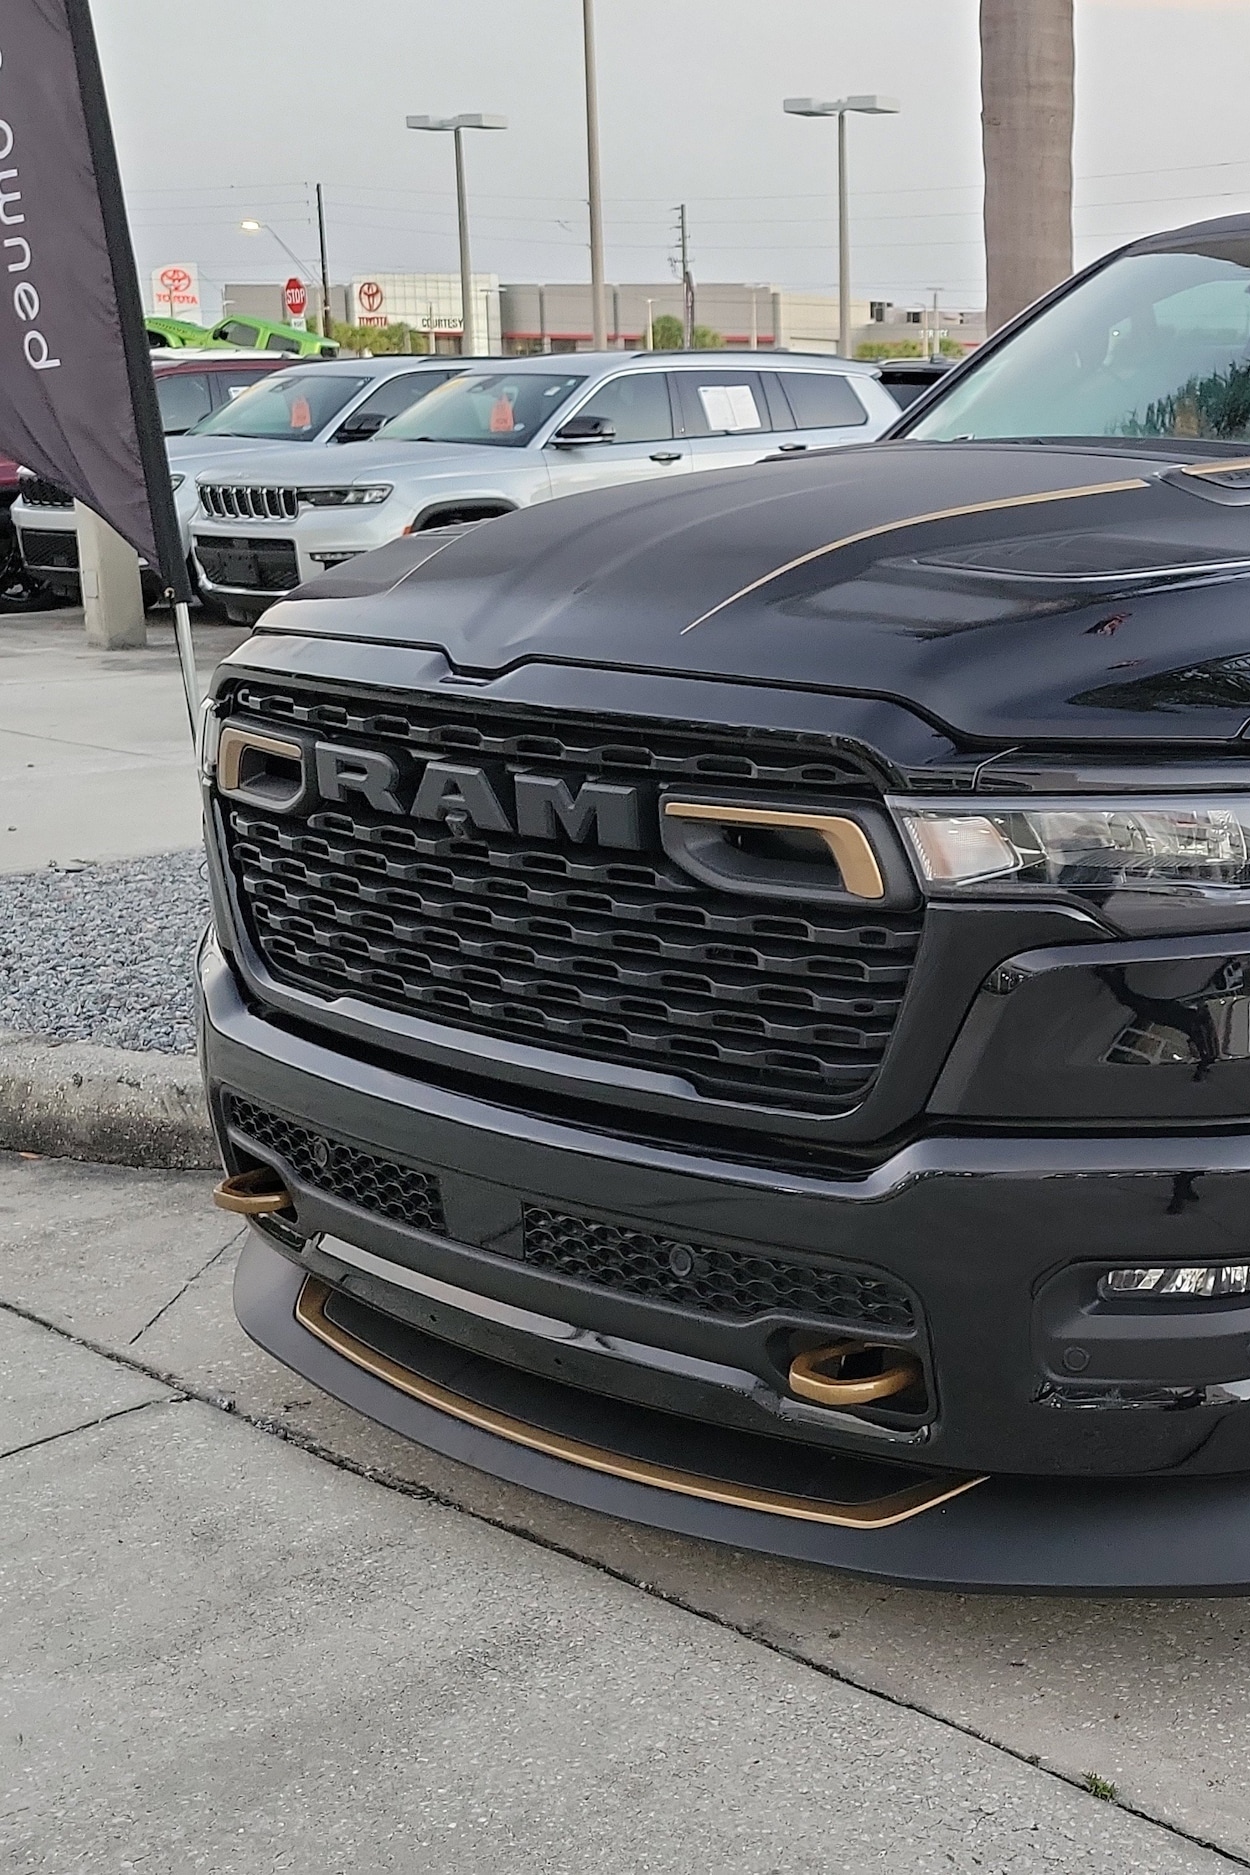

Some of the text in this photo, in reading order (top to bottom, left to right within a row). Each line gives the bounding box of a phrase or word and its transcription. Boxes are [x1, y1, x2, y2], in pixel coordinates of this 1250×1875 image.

[156, 293, 198, 305] TOYOTA
[286, 288, 305, 305] STOP
[421, 318, 464, 329] COURTESY
[315, 740, 642, 851] RAM
